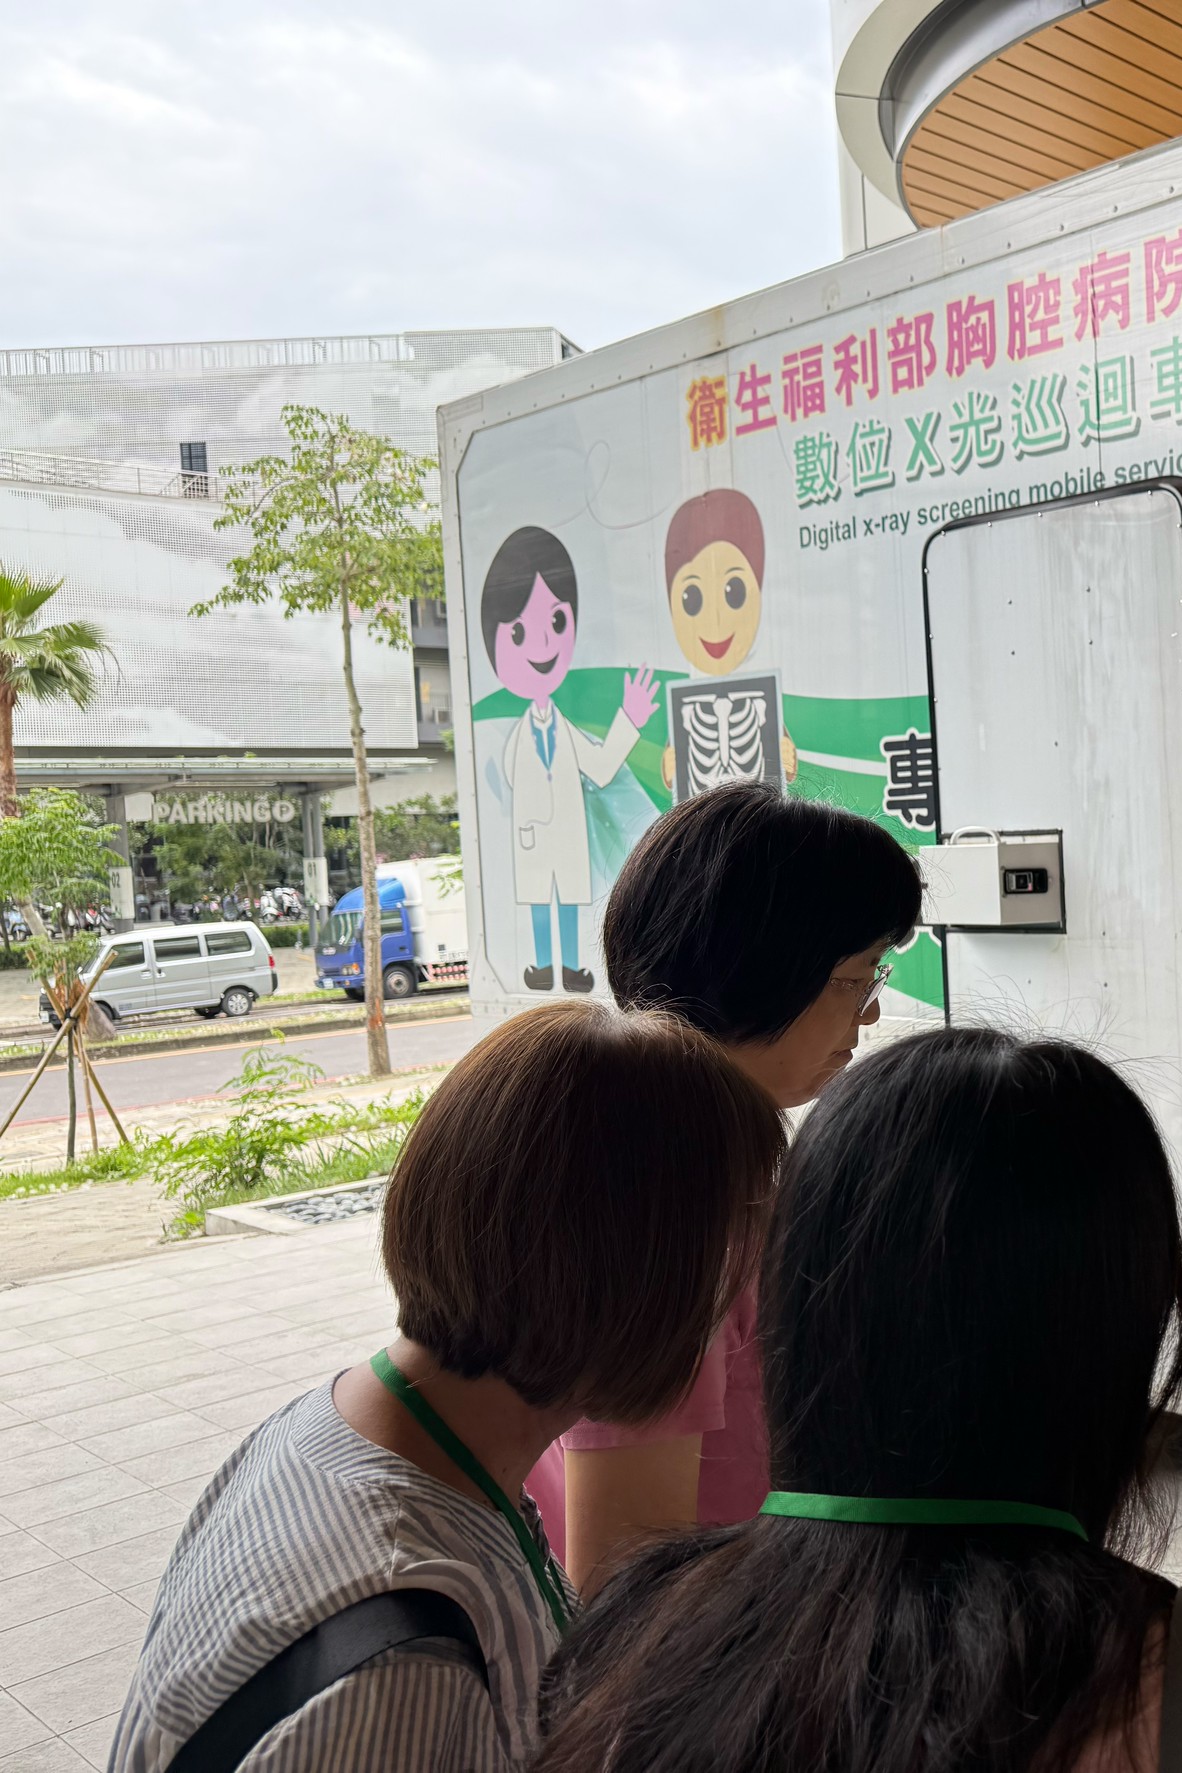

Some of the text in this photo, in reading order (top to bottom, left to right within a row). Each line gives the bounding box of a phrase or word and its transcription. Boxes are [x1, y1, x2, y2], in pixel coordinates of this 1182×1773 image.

[799, 516, 857, 551] Digital
[863, 507, 910, 536] x-ray
[917, 490, 1020, 524] screening
[1029, 470, 1105, 503] mobile
[153, 801, 272, 824] PARKING
